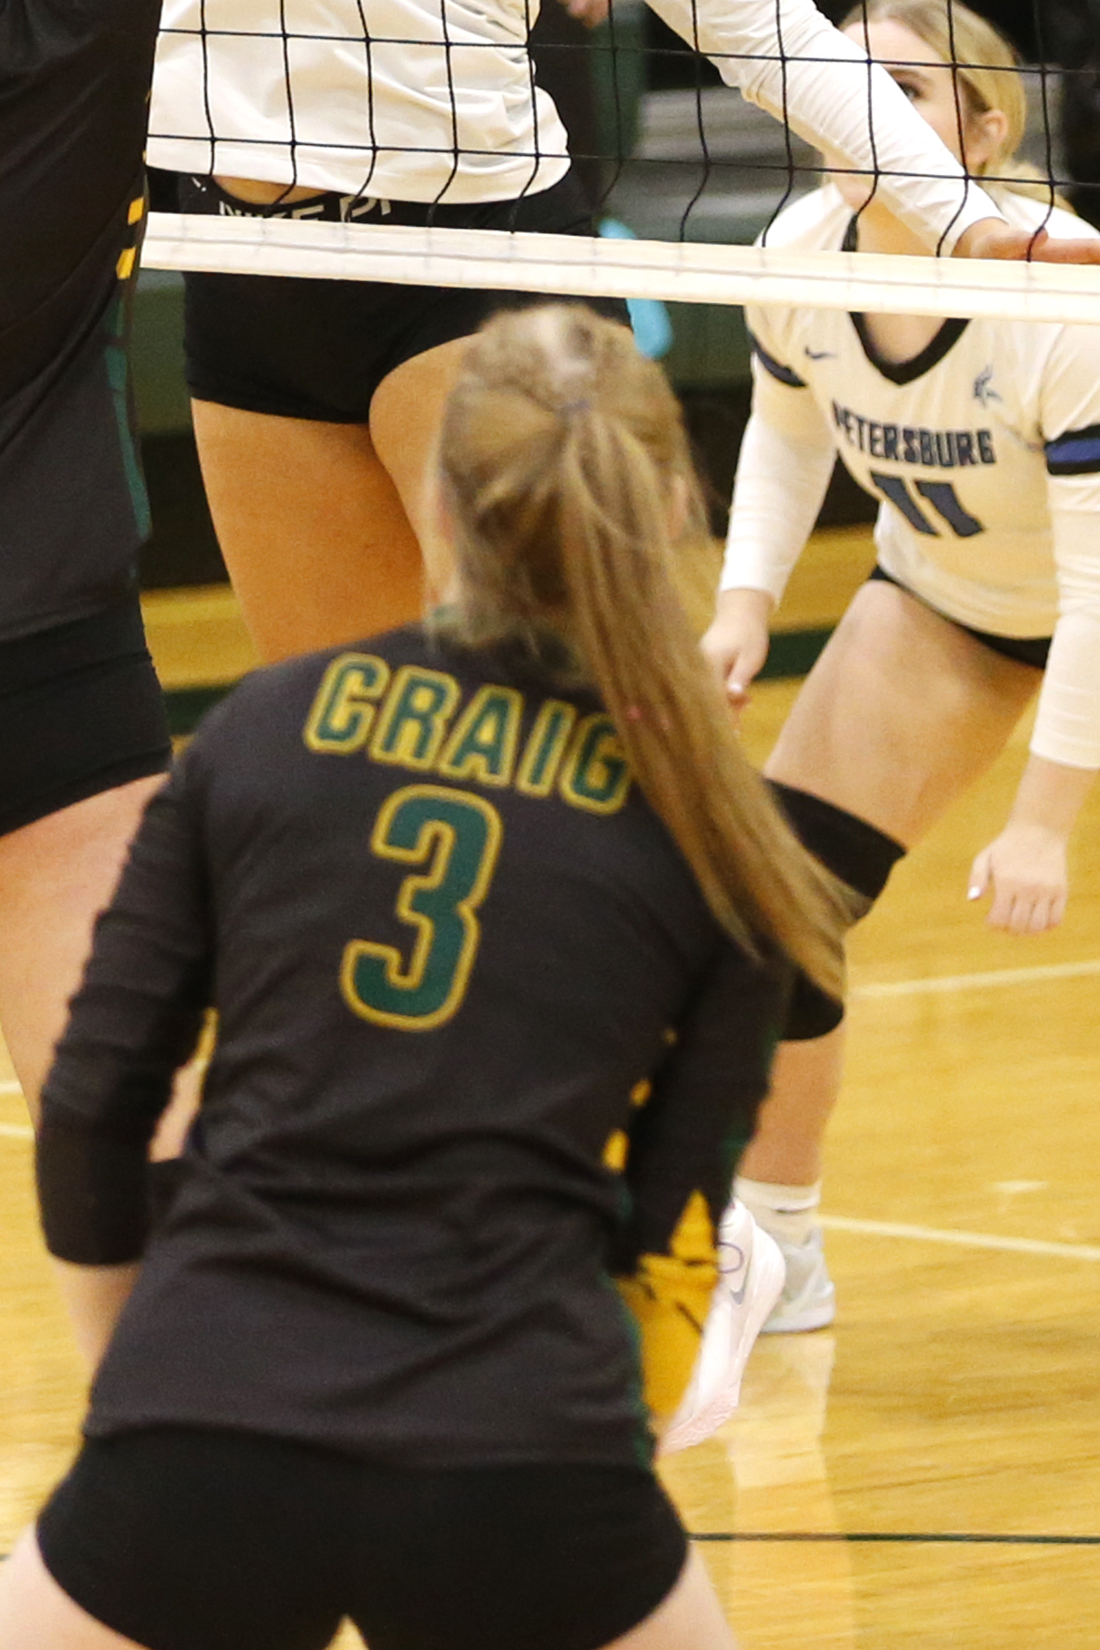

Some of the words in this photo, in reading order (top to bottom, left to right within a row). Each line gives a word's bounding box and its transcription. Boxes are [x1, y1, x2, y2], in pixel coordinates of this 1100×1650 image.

[869, 469, 985, 537] 11
[304, 651, 633, 815] CRAIG
[339, 783, 503, 1032] 3
